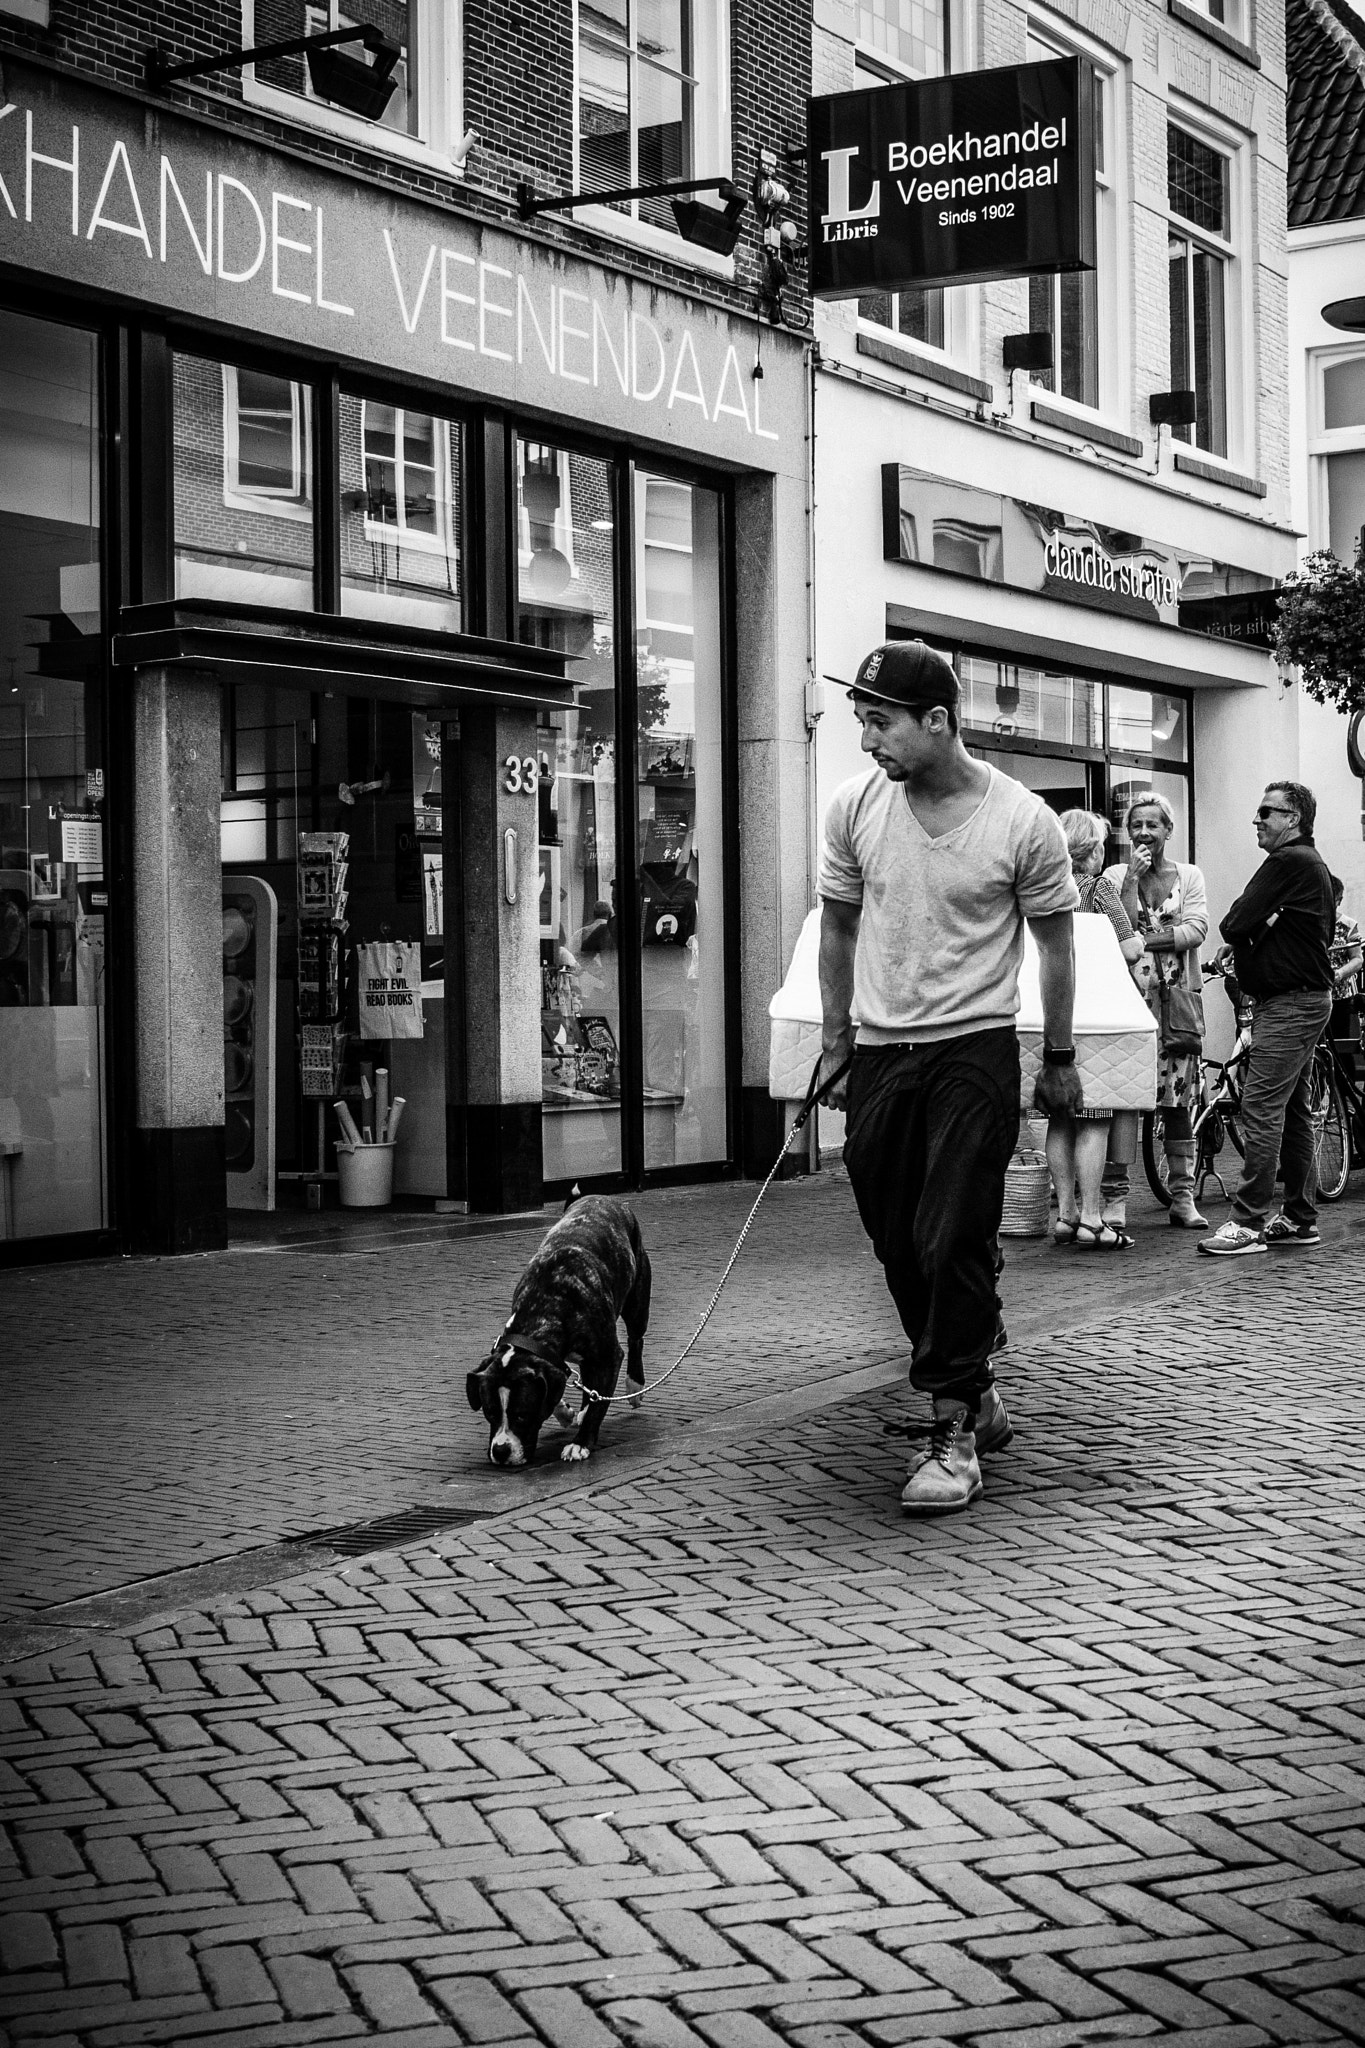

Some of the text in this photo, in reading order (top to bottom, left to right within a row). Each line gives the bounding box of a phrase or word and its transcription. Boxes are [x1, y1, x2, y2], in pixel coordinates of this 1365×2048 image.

[888, 117, 1067, 172] Boekhandel
[821, 146, 880, 224] L
[896, 158, 1058, 205] Veenendaal
[822, 220, 879, 243] Libris
[938, 203, 1015, 226] Sinds 1902
[384, 229, 779, 440] VEENENDAAL
[1044, 529, 1183, 608] claudia sträter
[505, 755, 538, 794] 33
[366, 993, 413, 1007] READ BOOKS
[367, 978, 409, 991] FIGHT EVIL
